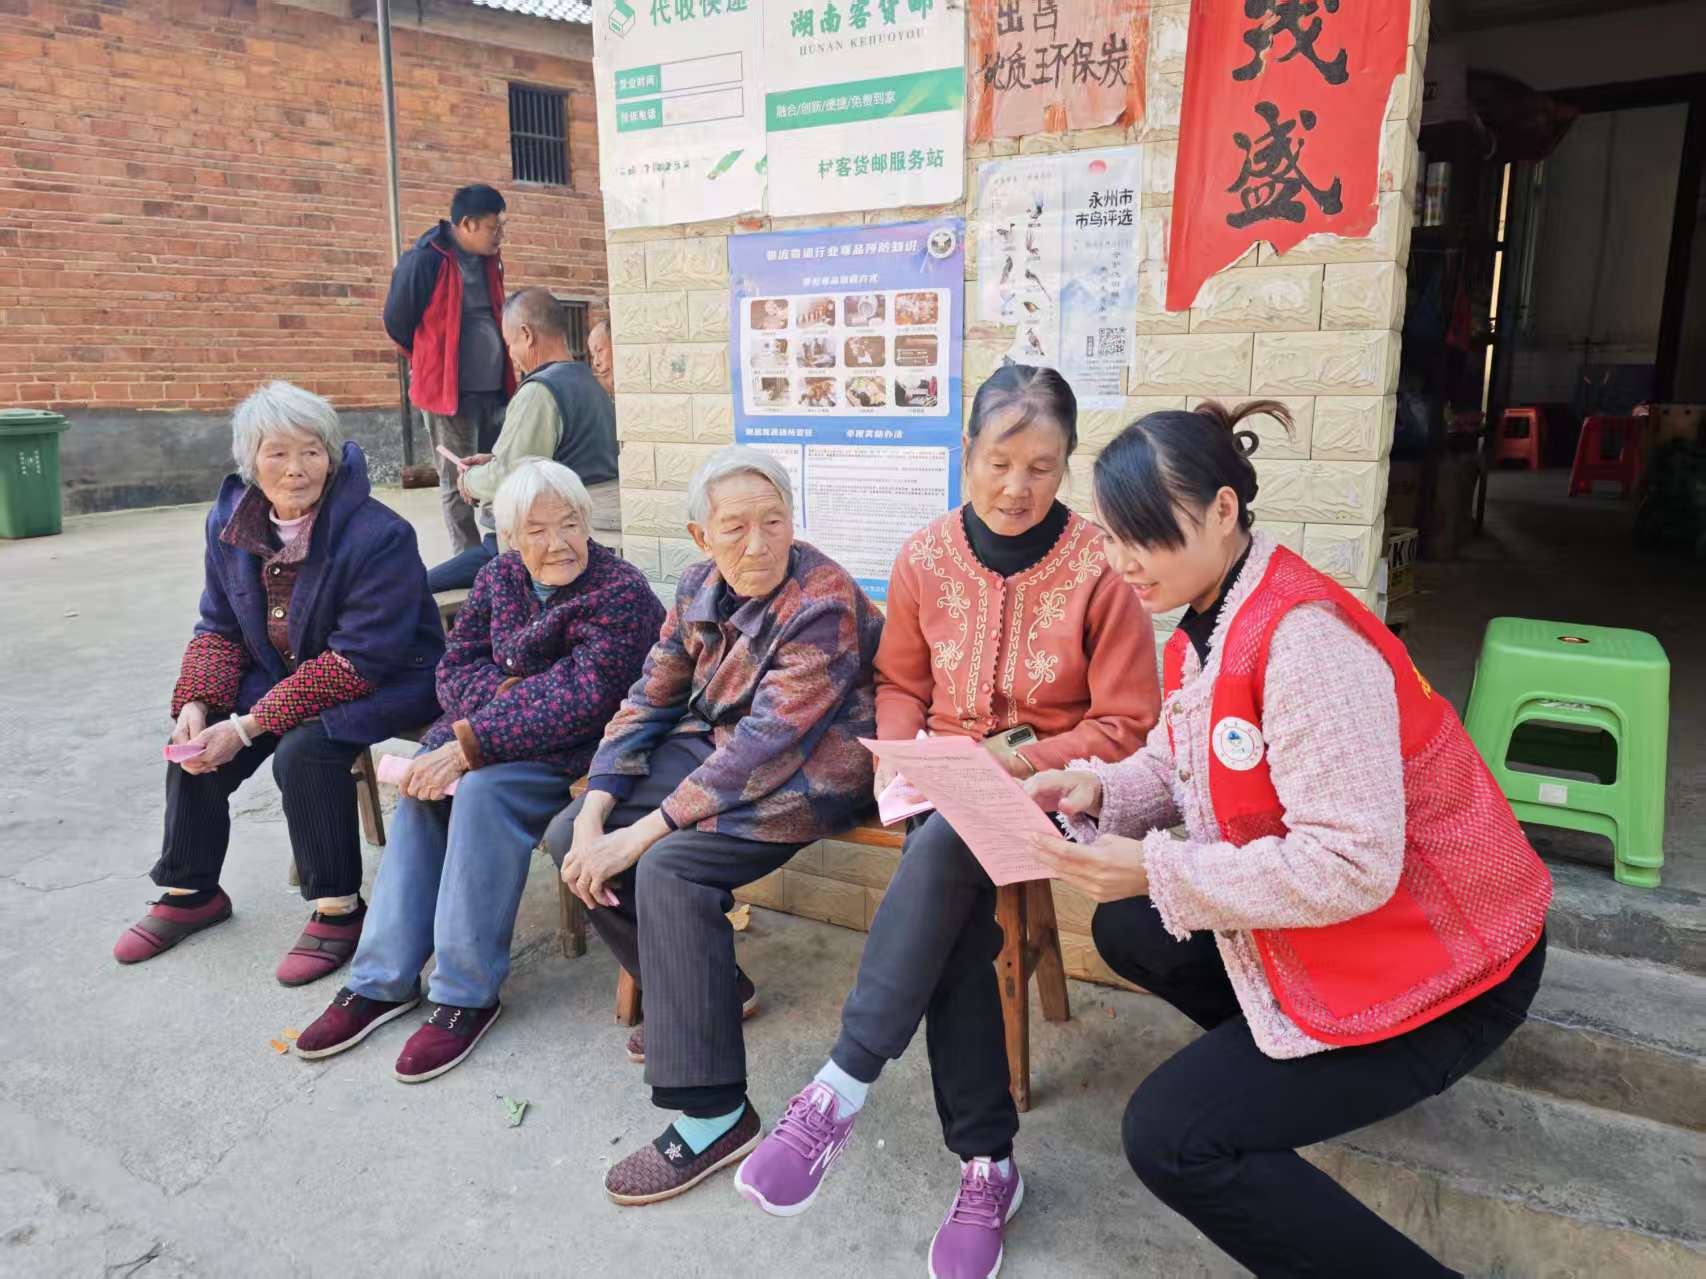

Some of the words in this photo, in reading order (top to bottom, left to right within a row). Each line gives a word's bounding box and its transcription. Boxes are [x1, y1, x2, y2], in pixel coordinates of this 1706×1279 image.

[799, 40, 844, 56] HUNAN
[849, 27, 923, 48] KEHUOYOU
[1088, 188, 1134, 209] 永州市
[1075, 208, 1133, 230] 市鸟评选
